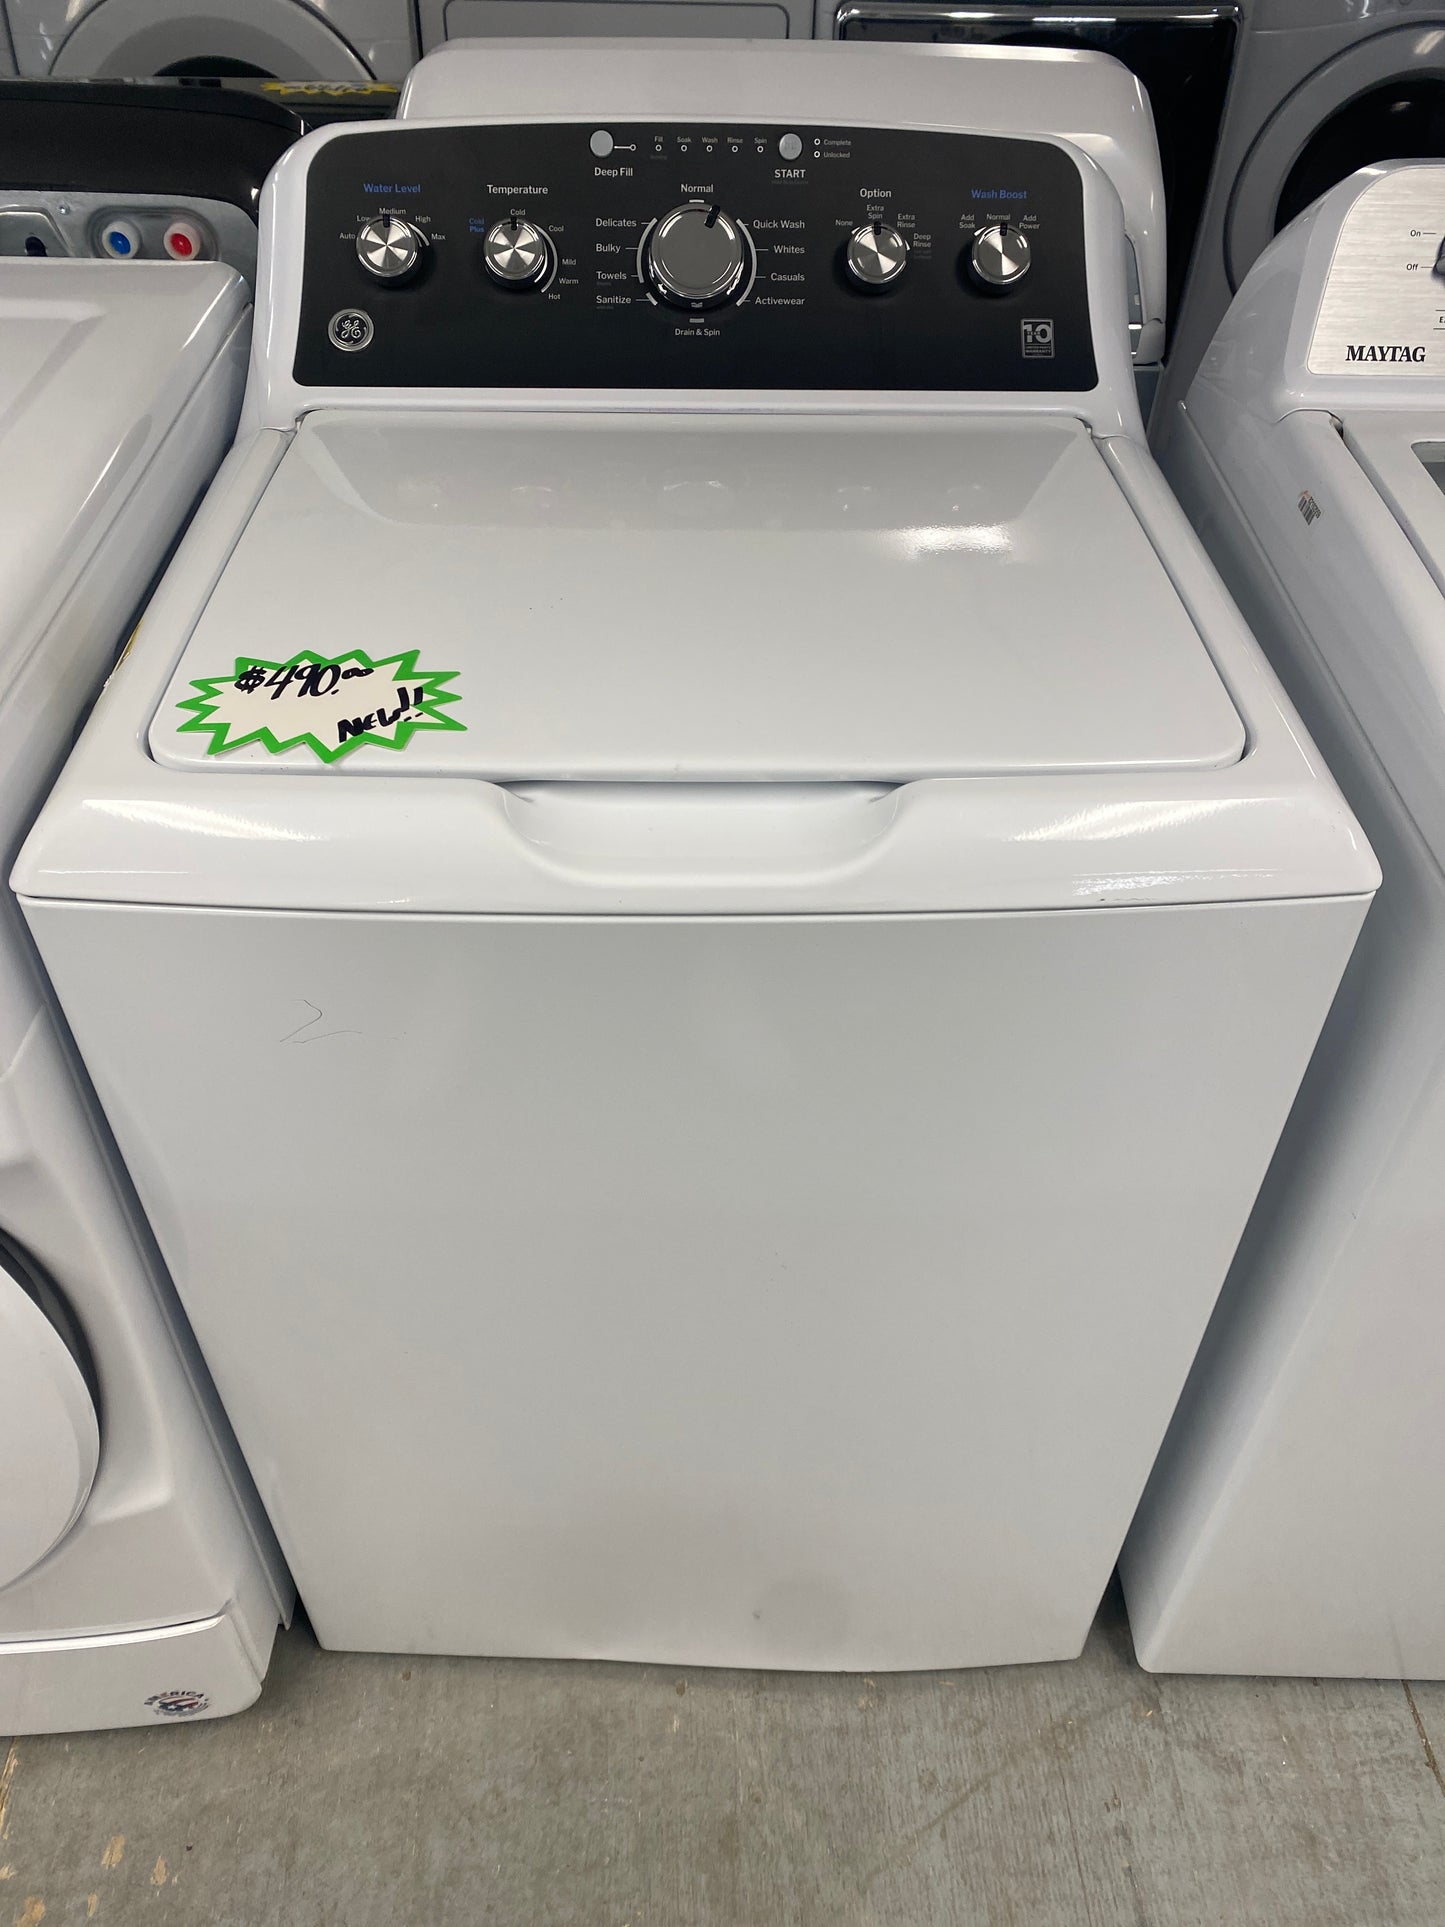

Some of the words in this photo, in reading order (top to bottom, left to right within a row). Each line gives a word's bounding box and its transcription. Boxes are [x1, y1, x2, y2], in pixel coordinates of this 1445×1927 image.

[754, 137, 767, 146] Spin
[823, 138, 851, 147] Complete
[823, 151, 850, 159] Unlocked
[594, 167, 617, 178] Deep
[620, 167, 633, 176] Fill
[774, 169, 806, 179] START
[363, 183, 393, 194] Water
[395, 183, 421, 194] Level
[487, 184, 549, 196] Temperature
[680, 183, 714, 193] Normal
[859, 188, 892, 199] Option
[971, 188, 998, 199] Wash
[1000, 189, 1028, 199] Boost
[379, 207, 407, 215] Medium
[510, 208, 526, 216] Cold
[866, 204, 885, 212] Extra
[415, 215, 432, 224] High
[867, 212, 883, 221] Spin
[897, 213, 916, 221] Extra
[960, 213, 975, 222] Add
[986, 213, 1011, 222] Normal
[1023, 214, 1037, 222] Add
[469, 218, 485, 226] Cold
[595, 217, 637, 228] Delicates
[753, 219, 778, 230] Quick
[780, 219, 805, 229] Wash
[835, 219, 853, 227] None
[897, 221, 916, 229] Rinse
[959, 222, 976, 230] Soak
[1019, 222, 1041, 231] Power
[469, 226, 485, 234] Plus
[548, 225, 565, 233] Cool
[1410, 229, 1421, 237] On
[339, 232, 356, 240] Auto
[431, 233, 447, 241] Max
[913, 233, 932, 242] Deep
[595, 243, 621, 254] Bulky
[912, 240, 932, 249] Rinse
[773, 245, 805, 255] Whites
[562, 258, 577, 266] Mild
[1406, 263, 1419, 271] Off
[596, 271, 627, 280] Towels
[770, 272, 805, 282] Casuals
[559, 277, 579, 286] Warm
[548, 293, 561, 301] Hot
[596, 295, 632, 305] Sanitize
[755, 296, 805, 306] Activewear
[674, 328, 695, 337] Drain
[696, 328, 703, 337] &
[703, 328, 721, 338] Spin
[1345, 345, 1426, 363] MAYTAG
